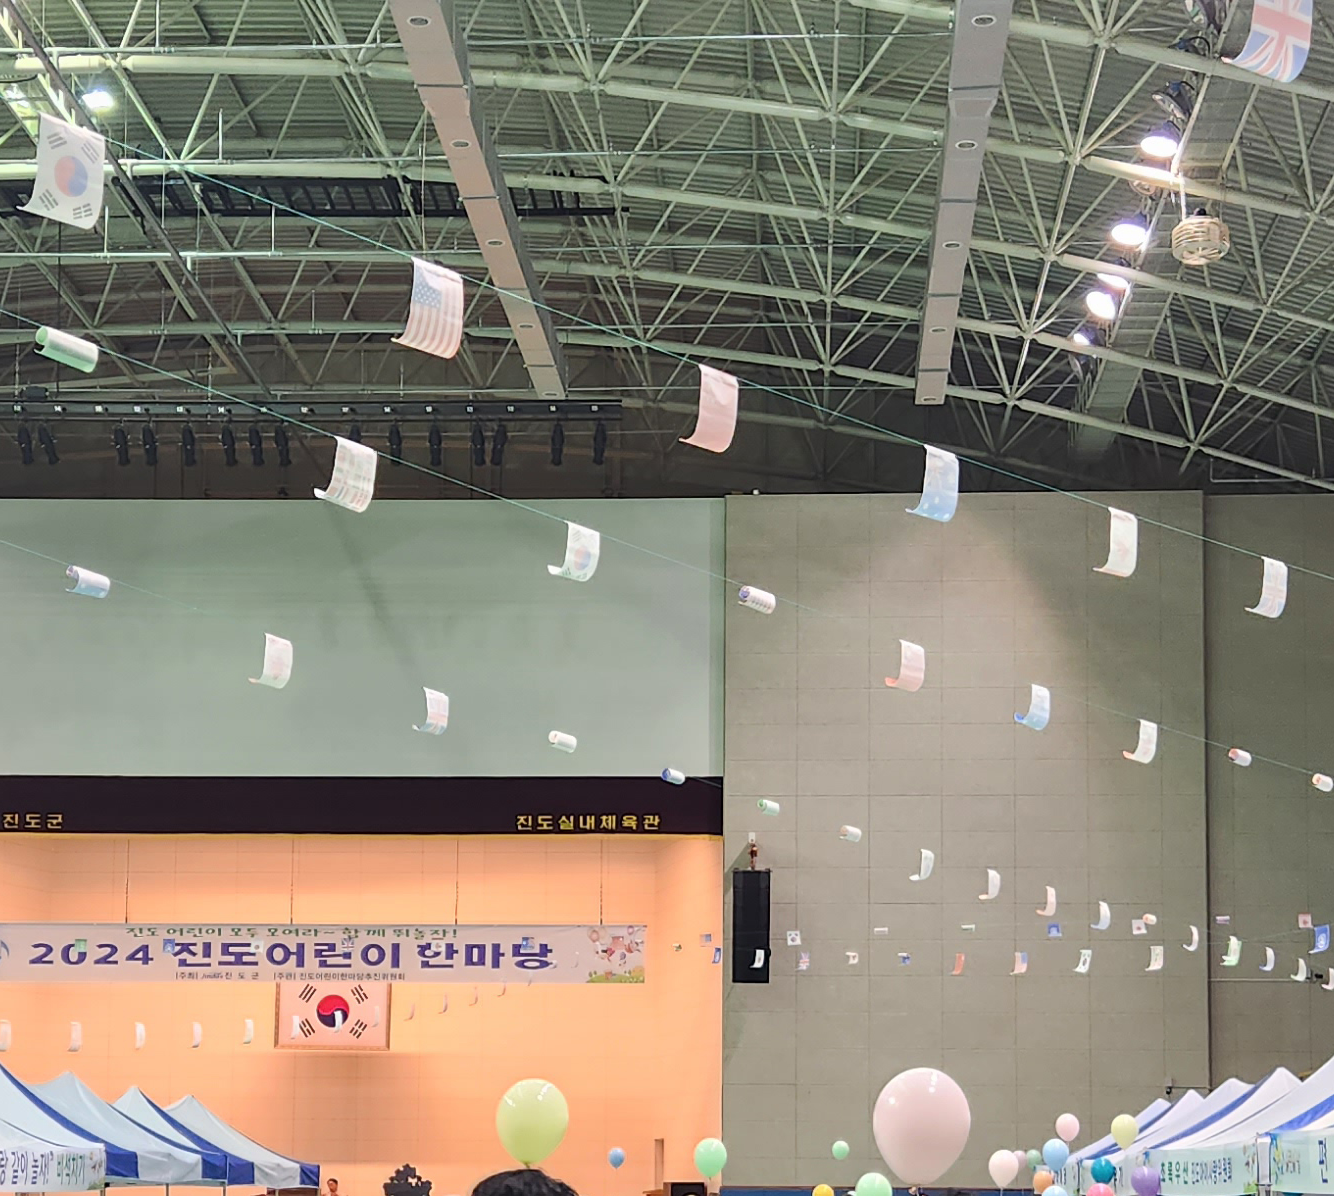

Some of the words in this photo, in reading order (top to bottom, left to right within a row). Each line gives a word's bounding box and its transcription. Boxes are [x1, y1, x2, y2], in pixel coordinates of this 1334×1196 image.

[3, 813, 63, 829] 진도군
[516, 815, 660, 830] 진도실내체육관
[166, 927, 222, 938] 어린이
[29, 943, 154, 966] 2024
[173, 941, 401, 969] 진도어린이
[417, 942, 553, 969] 한마당
[11, 1150, 29, 1186] 같이
[56, 1152, 86, 1185] 비석치기
